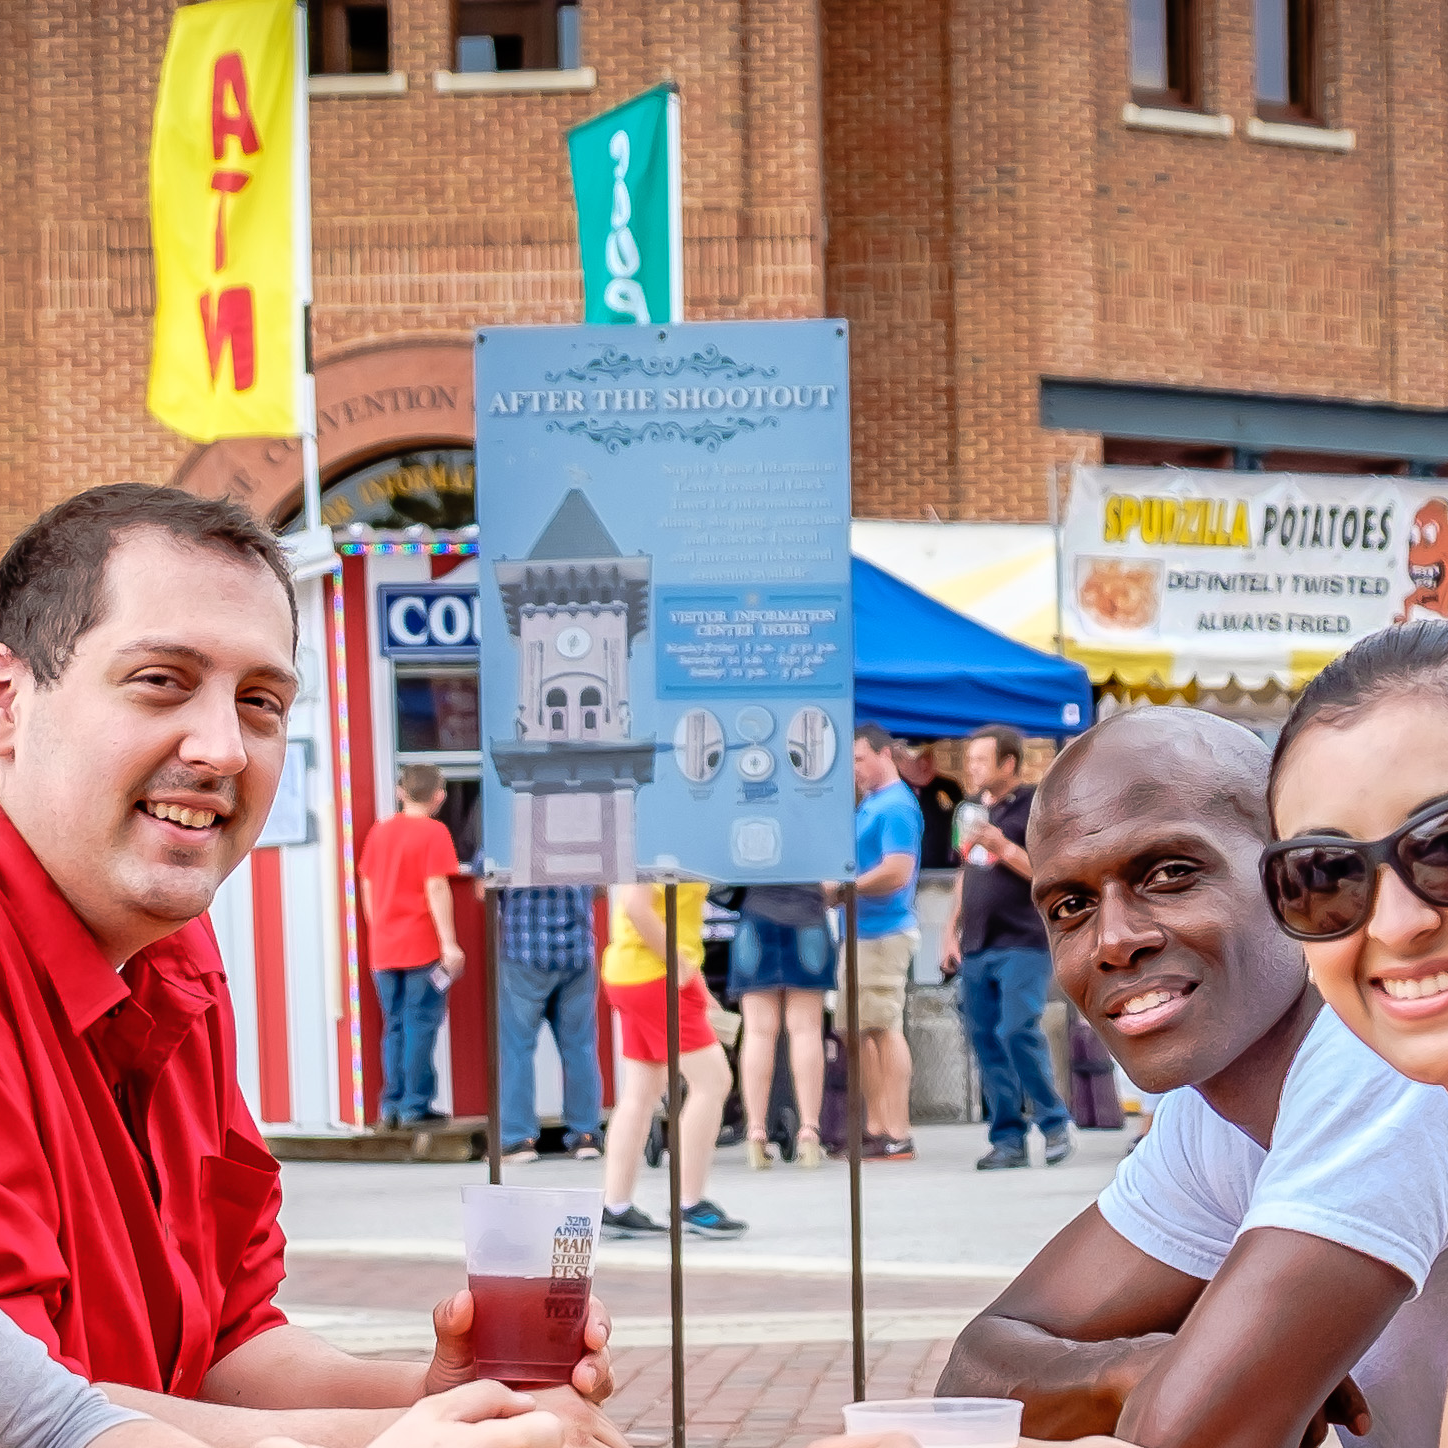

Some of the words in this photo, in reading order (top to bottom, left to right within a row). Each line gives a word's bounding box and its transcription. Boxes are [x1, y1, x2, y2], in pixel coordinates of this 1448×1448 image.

[489, 388, 586, 415] AFTER
[591, 386, 654, 411] THE
[661, 384, 836, 411] SHOOTOUT
[1104, 494, 1251, 548] SPUDZILLA
[1261, 504, 1394, 551] POTATOES
[1168, 570, 1283, 596] DEFINITELY
[1292, 575, 1391, 597] TWISTED
[1197, 612, 1281, 633] ALWAYS
[1287, 614, 1351, 634] FRIED
[565, 1215, 591, 1226] 32ND
[553, 1238, 593, 1254] MAIN
